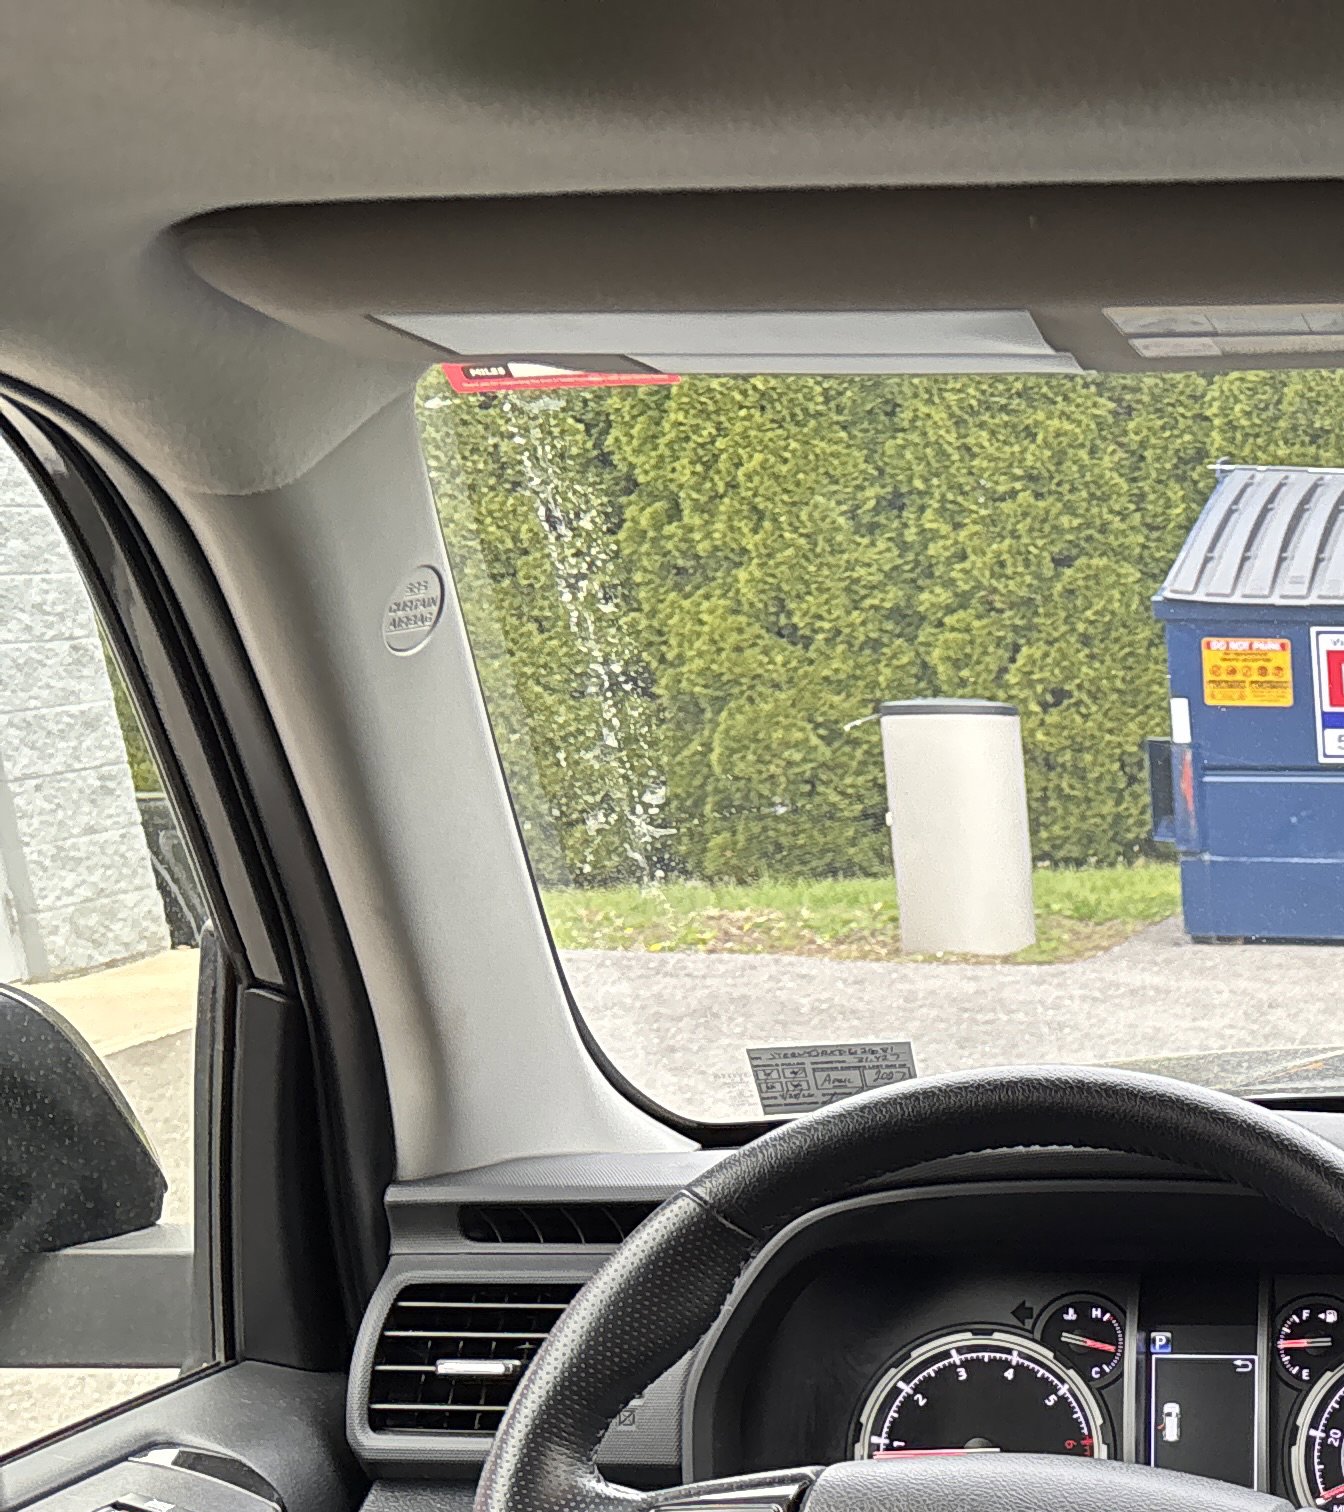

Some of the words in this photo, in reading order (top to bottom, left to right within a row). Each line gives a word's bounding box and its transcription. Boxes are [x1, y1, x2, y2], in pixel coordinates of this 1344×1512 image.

[1091, 1308, 1102, 1319] H
[1302, 1309, 1311, 1322] F
[1154, 1335, 1167, 1349] P
[956, 1367, 968, 1381] 3
[1003, 1368, 1015, 1382] 4
[1090, 1366, 1101, 1379] C
[1301, 1369, 1310, 1381] E
[913, 1393, 928, 1407] 2
[1044, 1394, 1058, 1407] 5
[892, 1440, 906, 1448] 1
[1327, 1428, 1342, 1448] 20
